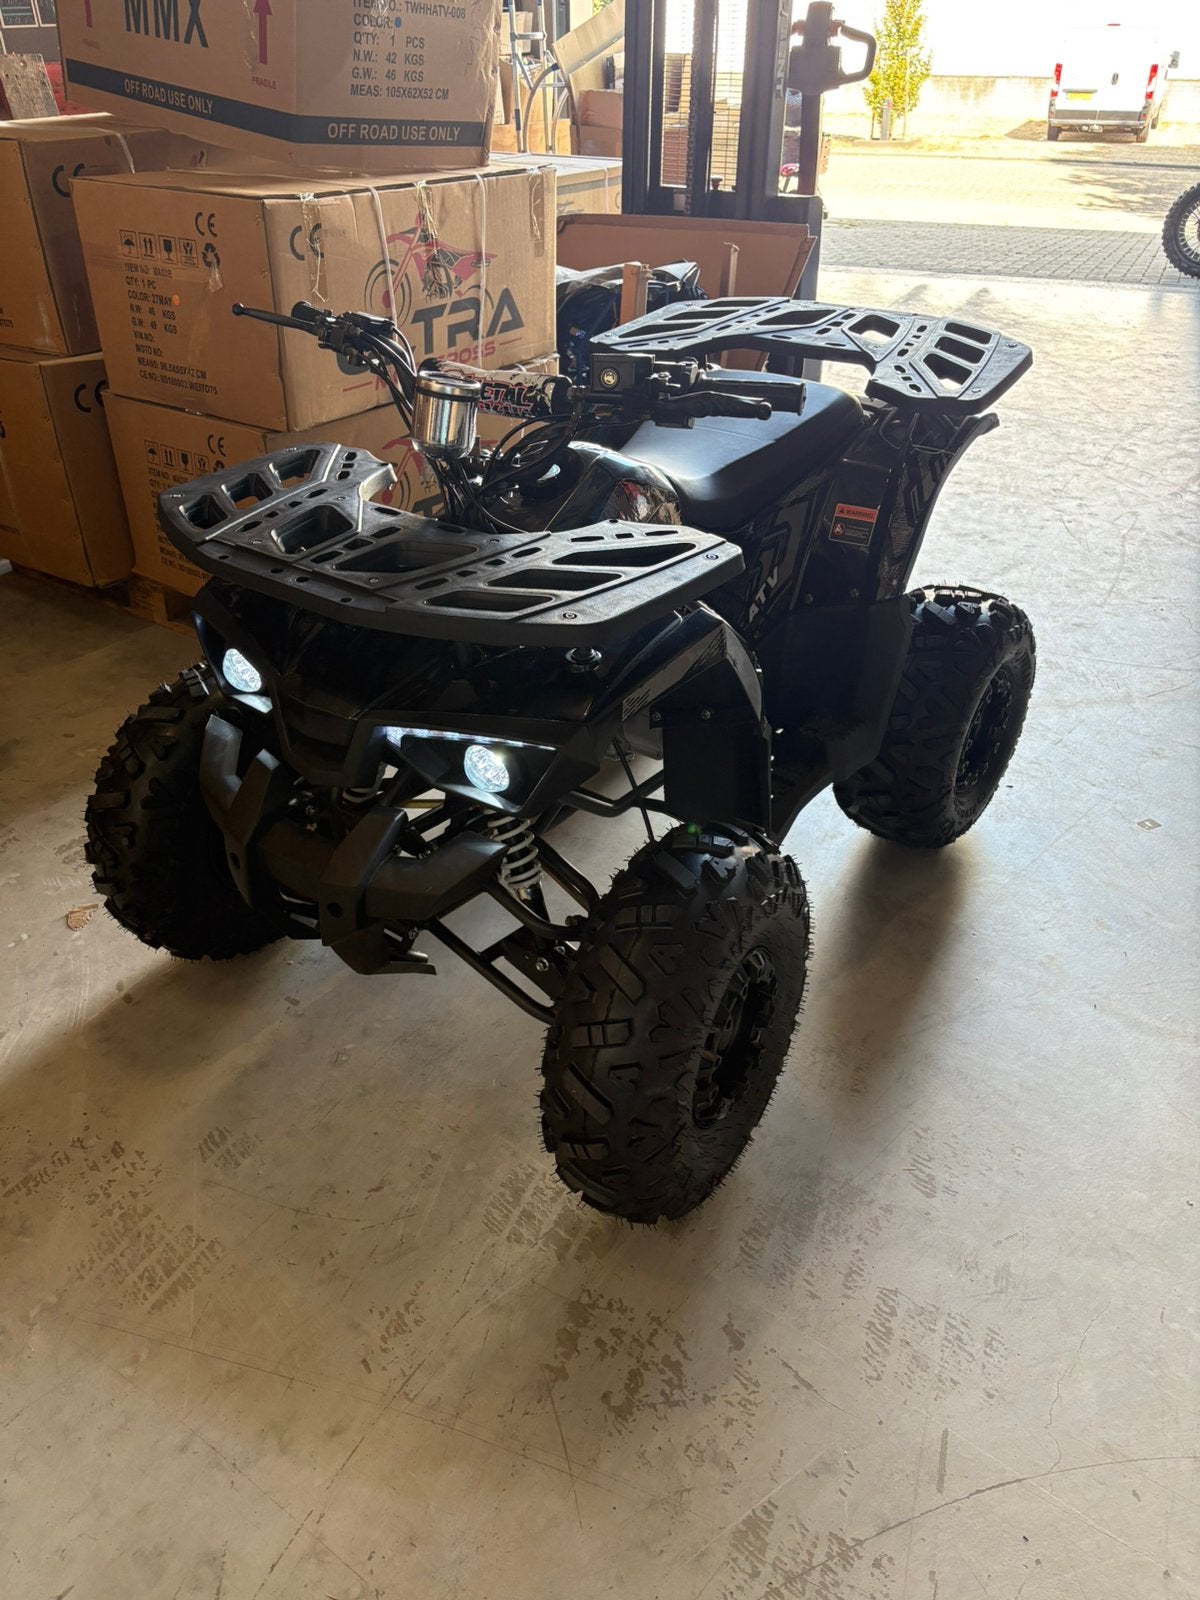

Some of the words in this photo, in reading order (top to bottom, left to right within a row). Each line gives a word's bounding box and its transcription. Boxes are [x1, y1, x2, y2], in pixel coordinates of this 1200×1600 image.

[353, 13, 394, 29] COLOR:
[390, 34, 395, 47] 1
[405, 35, 425, 49] PCS
[385, 52, 397, 64] 42
[404, 53, 424, 66] KGS
[384, 69, 396, 81] 46
[403, 70, 424, 83] KGS
[123, 78, 143, 96] OFF
[141, 84, 167, 104] ROAD
[167, 91, 187, 107] USE
[187, 94, 214, 115] ONLY
[350, 84, 382, 98] MEAS:
[386, 86, 433, 100] 105X62X52
[435, 88, 449, 100] CM
[327, 122, 357, 140] OFF
[360, 123, 398, 141] ROAD
[401, 125, 427, 141] USE
[428, 126, 461, 142] ONLY
[195, 211, 218, 238] CE
[749, 566, 778, 623] ATV
